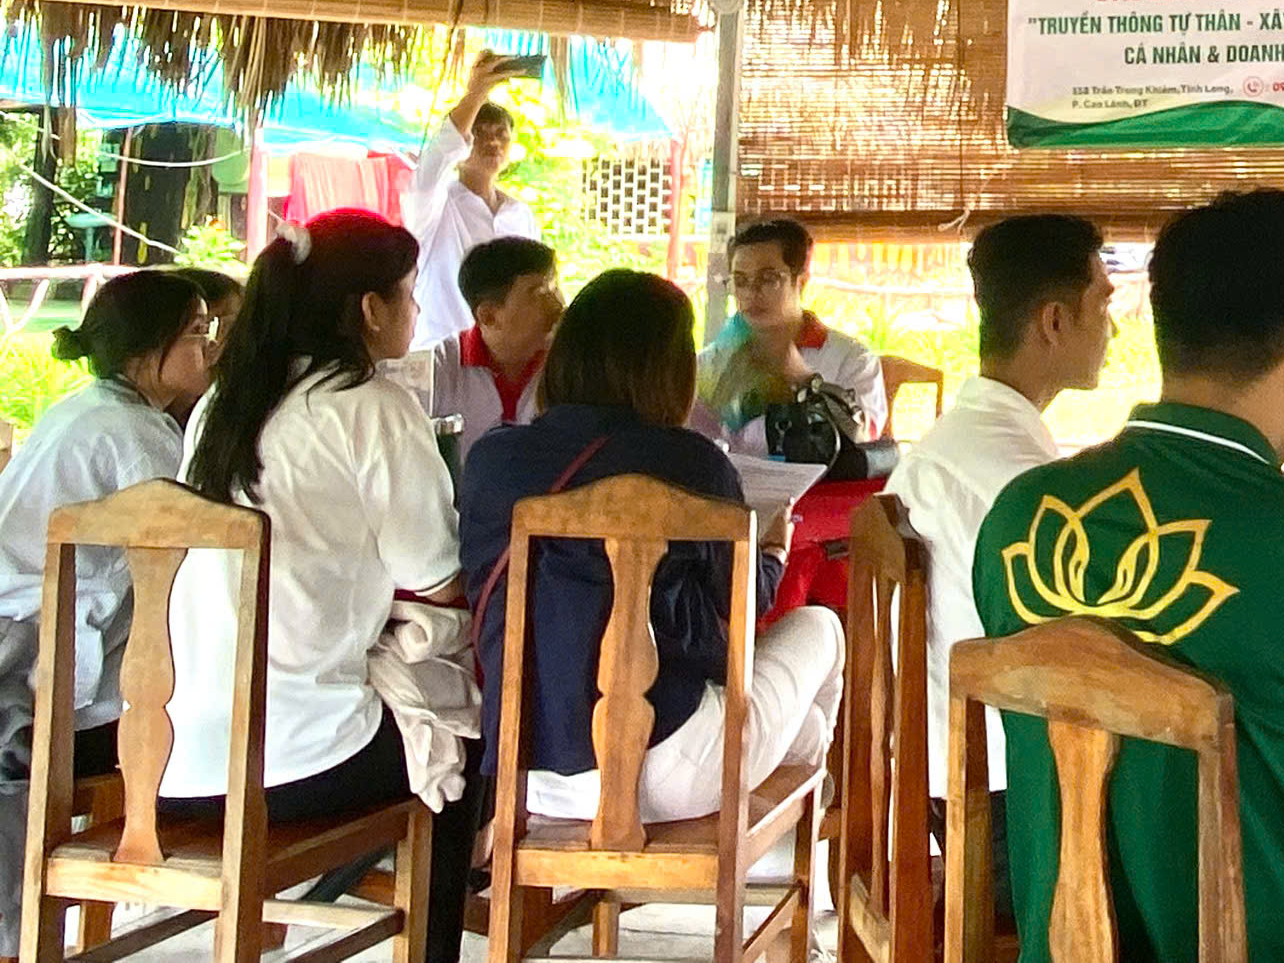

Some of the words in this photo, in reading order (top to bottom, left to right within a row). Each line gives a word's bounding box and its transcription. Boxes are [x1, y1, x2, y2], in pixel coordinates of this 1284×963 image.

[1108, 10, 1163, 34] THÔNG
[1170, 12, 1192, 36] TỰ
[1197, 8, 1241, 32] THÂN
[1124, 42, 1147, 65] CÁ
[1153, 41, 1201, 65] NHÂN
[1207, 46, 1219, 63] &
[1226, 44, 1284, 64] DOANH
